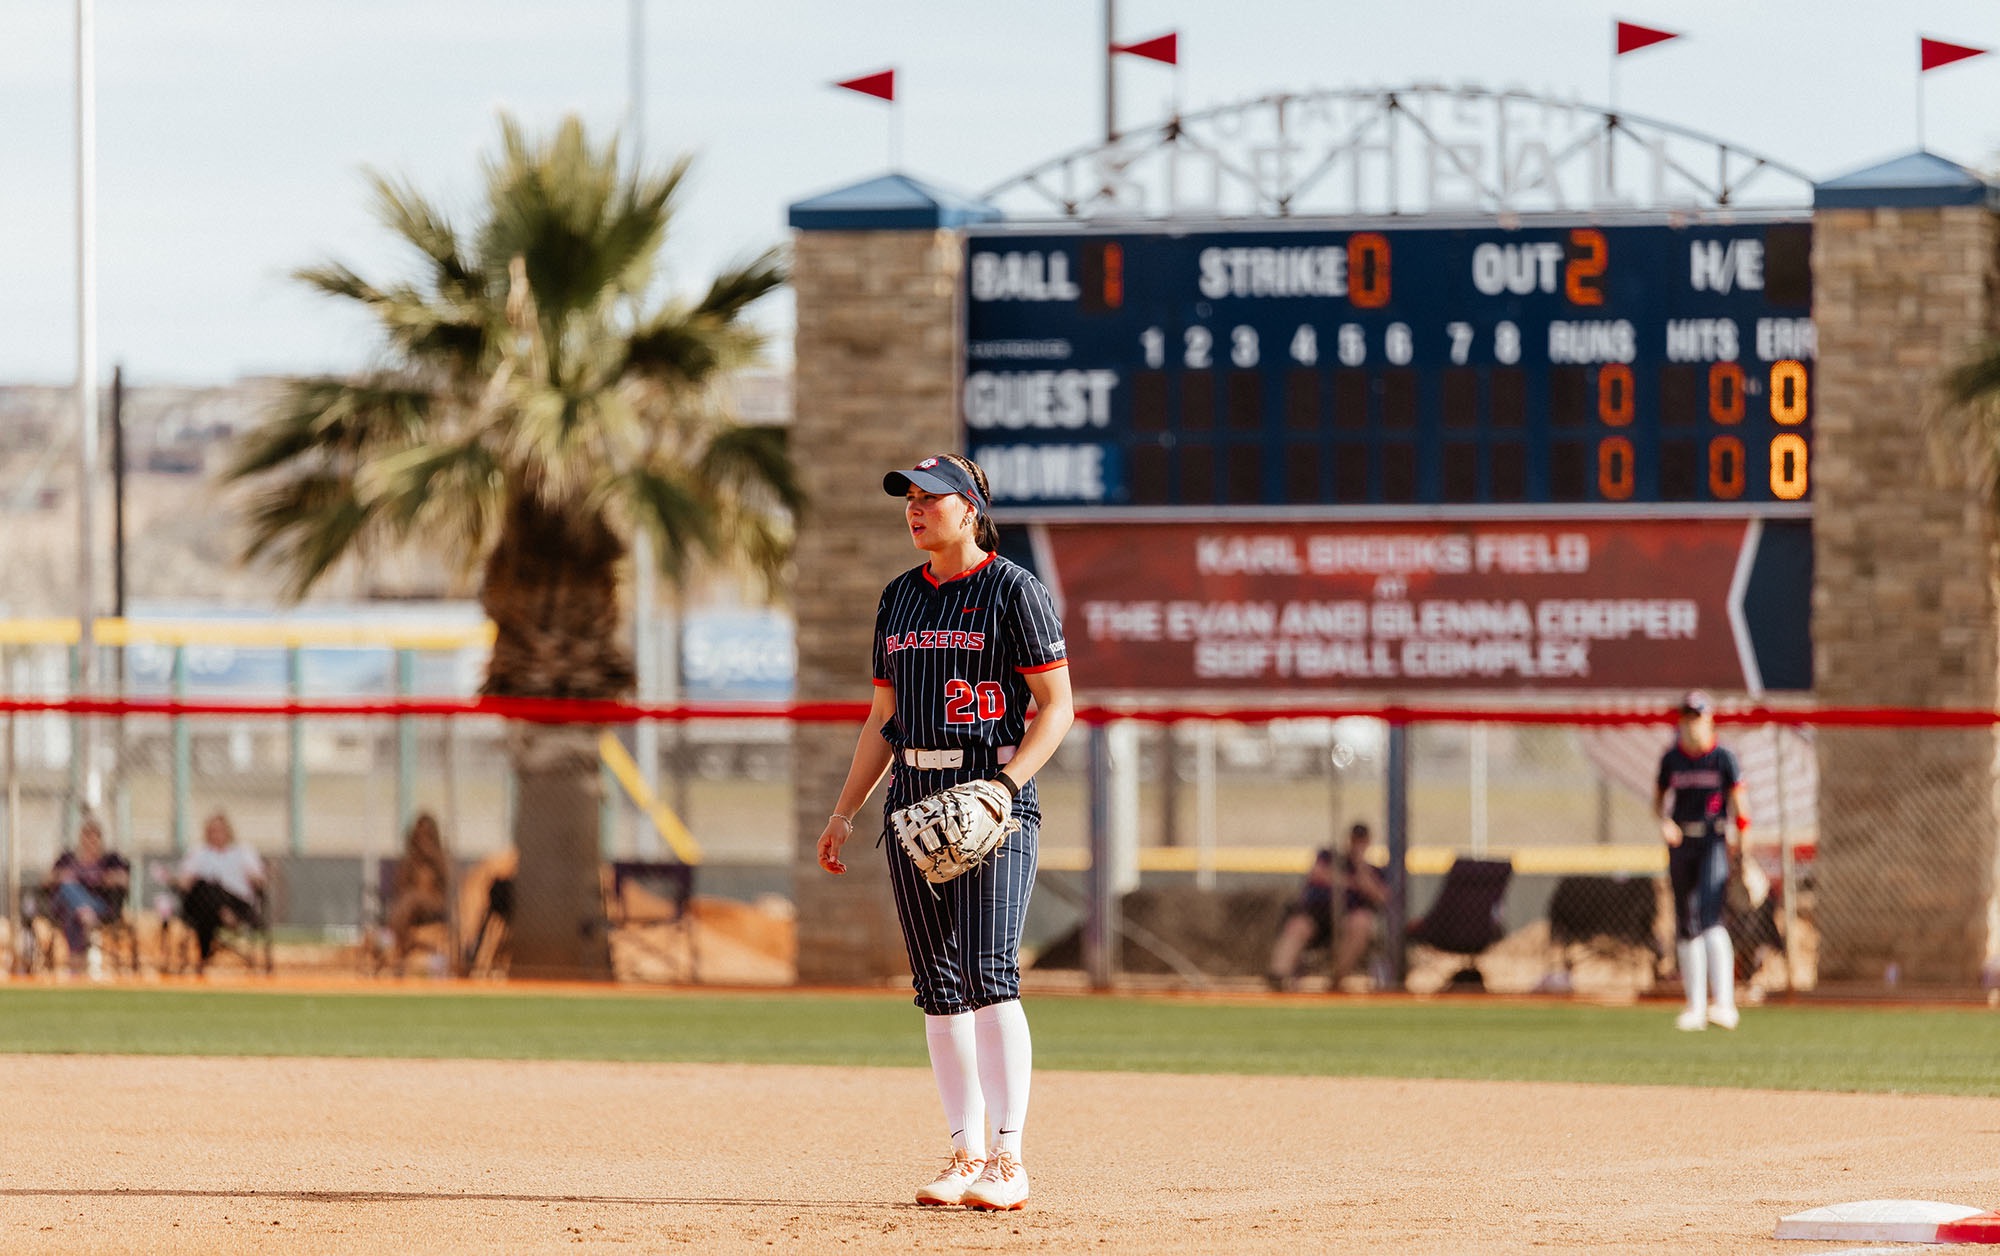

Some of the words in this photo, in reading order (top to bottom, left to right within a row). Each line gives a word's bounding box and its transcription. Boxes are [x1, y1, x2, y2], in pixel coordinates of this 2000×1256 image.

[971, 250, 1079, 301] BALL
[1199, 246, 1348, 299] STRIKE
[1348, 232, 1391, 309] 0
[1472, 242, 1562, 296] OUT
[1565, 229, 1608, 307] 2
[1690, 238, 1765, 295] H/E
[1141, 326, 1165, 368] 1
[1184, 325, 1213, 368] 2
[1230, 324, 1260, 367] 3
[1290, 323, 1318, 366] 4
[1338, 323, 1367, 366] 5
[1385, 322, 1413, 365] 6
[1447, 322, 1474, 365] 7
[1494, 320, 1521, 365] 8
[1548, 319, 1637, 364] RUNS
[1666, 318, 1739, 362] HITS
[965, 370, 1118, 429] GUEST
[1598, 363, 1635, 426] 0
[1709, 362, 1746, 426] 0
[1770, 360, 1808, 426] 0
[1598, 436, 1635, 500] 0
[1709, 435, 1746, 500] 0
[1770, 433, 1808, 500] 0
[1196, 535, 1300, 575] KARL
[1306, 535, 1472, 575] BROOKS
[1474, 533, 1590, 573] FIELD
[886, 630, 985, 655] BLAZERS
[1085, 602, 1161, 641] THE
[1166, 601, 1275, 640] EVAN
[1280, 601, 1369, 639] AND
[1371, 600, 1533, 639] GLENNA
[1536, 600, 1697, 639] COOPER
[1195, 640, 1399, 678] SOFTBALL
[1402, 639, 1590, 677] COMPLEX
[944, 678, 1006, 724] 20
